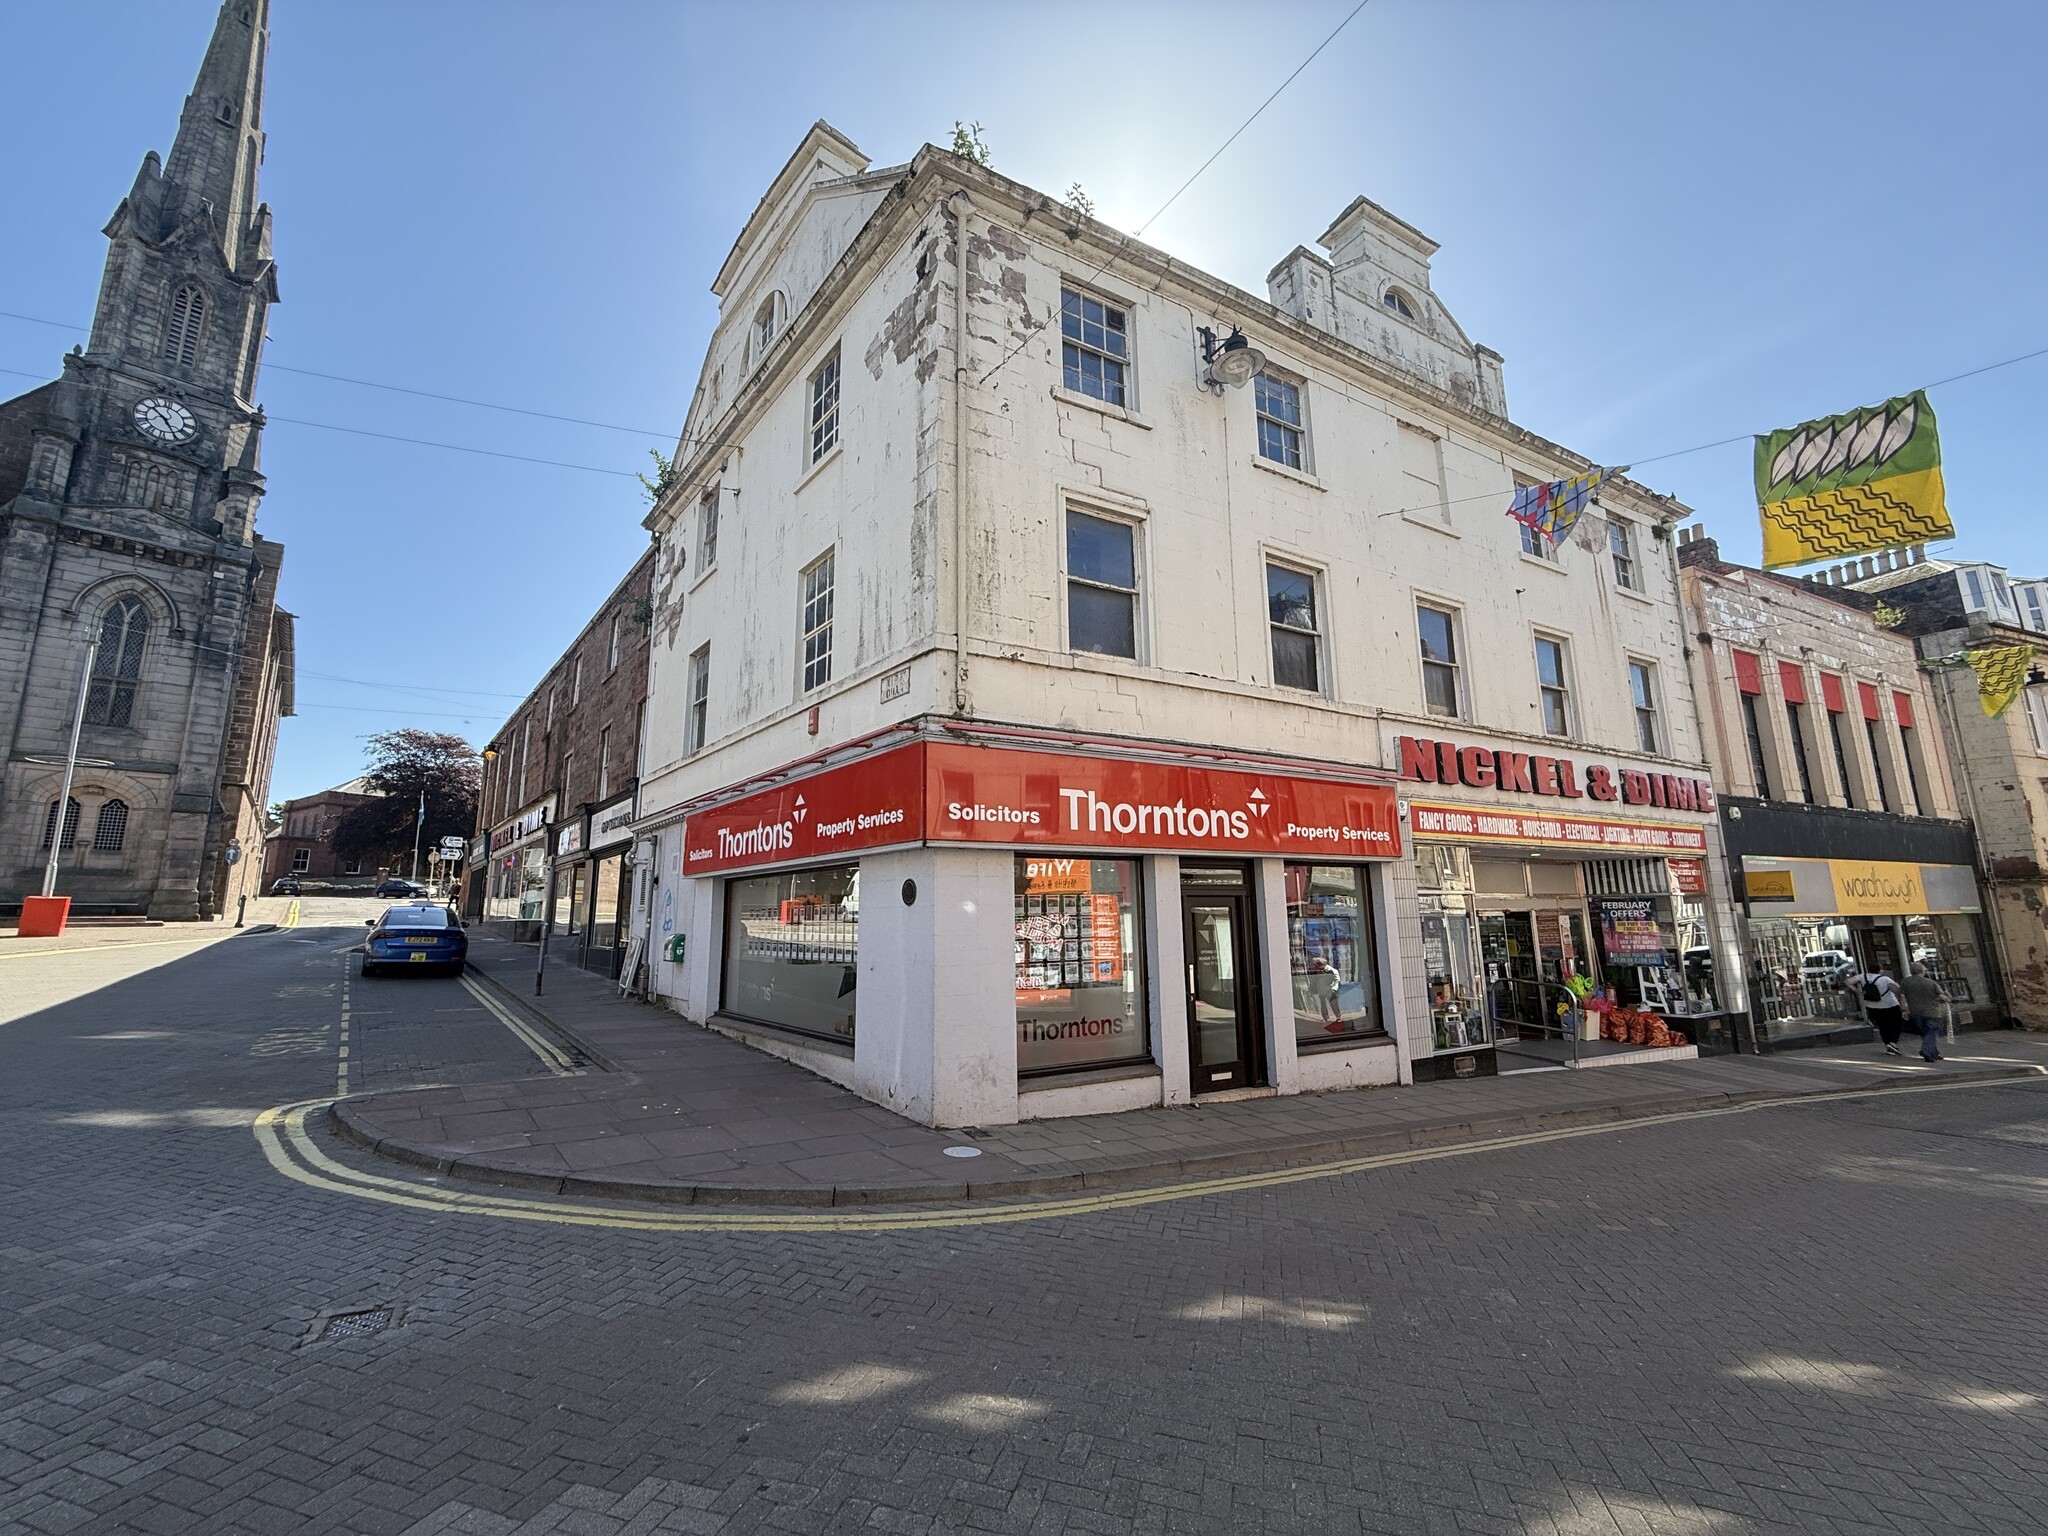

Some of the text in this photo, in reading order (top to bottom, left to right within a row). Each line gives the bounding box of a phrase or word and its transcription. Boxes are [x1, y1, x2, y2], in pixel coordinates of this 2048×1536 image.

[1394, 735, 1717, 813] NICKEL & DIME
[816, 808, 904, 838] Property Services
[948, 803, 1041, 824] Solicitors
[1059, 788, 1249, 839] Thorntons
[718, 819, 793, 859] Thorntons
[1287, 823, 1390, 842] Property Services
[1418, 811, 1702, 848] FANCY GOODS HARDWARE HOUSEHOLD ELECTRICAL LIGHTING PARTY GOODS STATIONERY
[689, 848, 713, 862] Solicitors
[1841, 866, 1918, 904] wardhaugh
[1602, 901, 1651, 910] FEBRUARY
[1610, 909, 1647, 918] OFFERS
[1017, 1016, 1123, 1043] Thorntons
